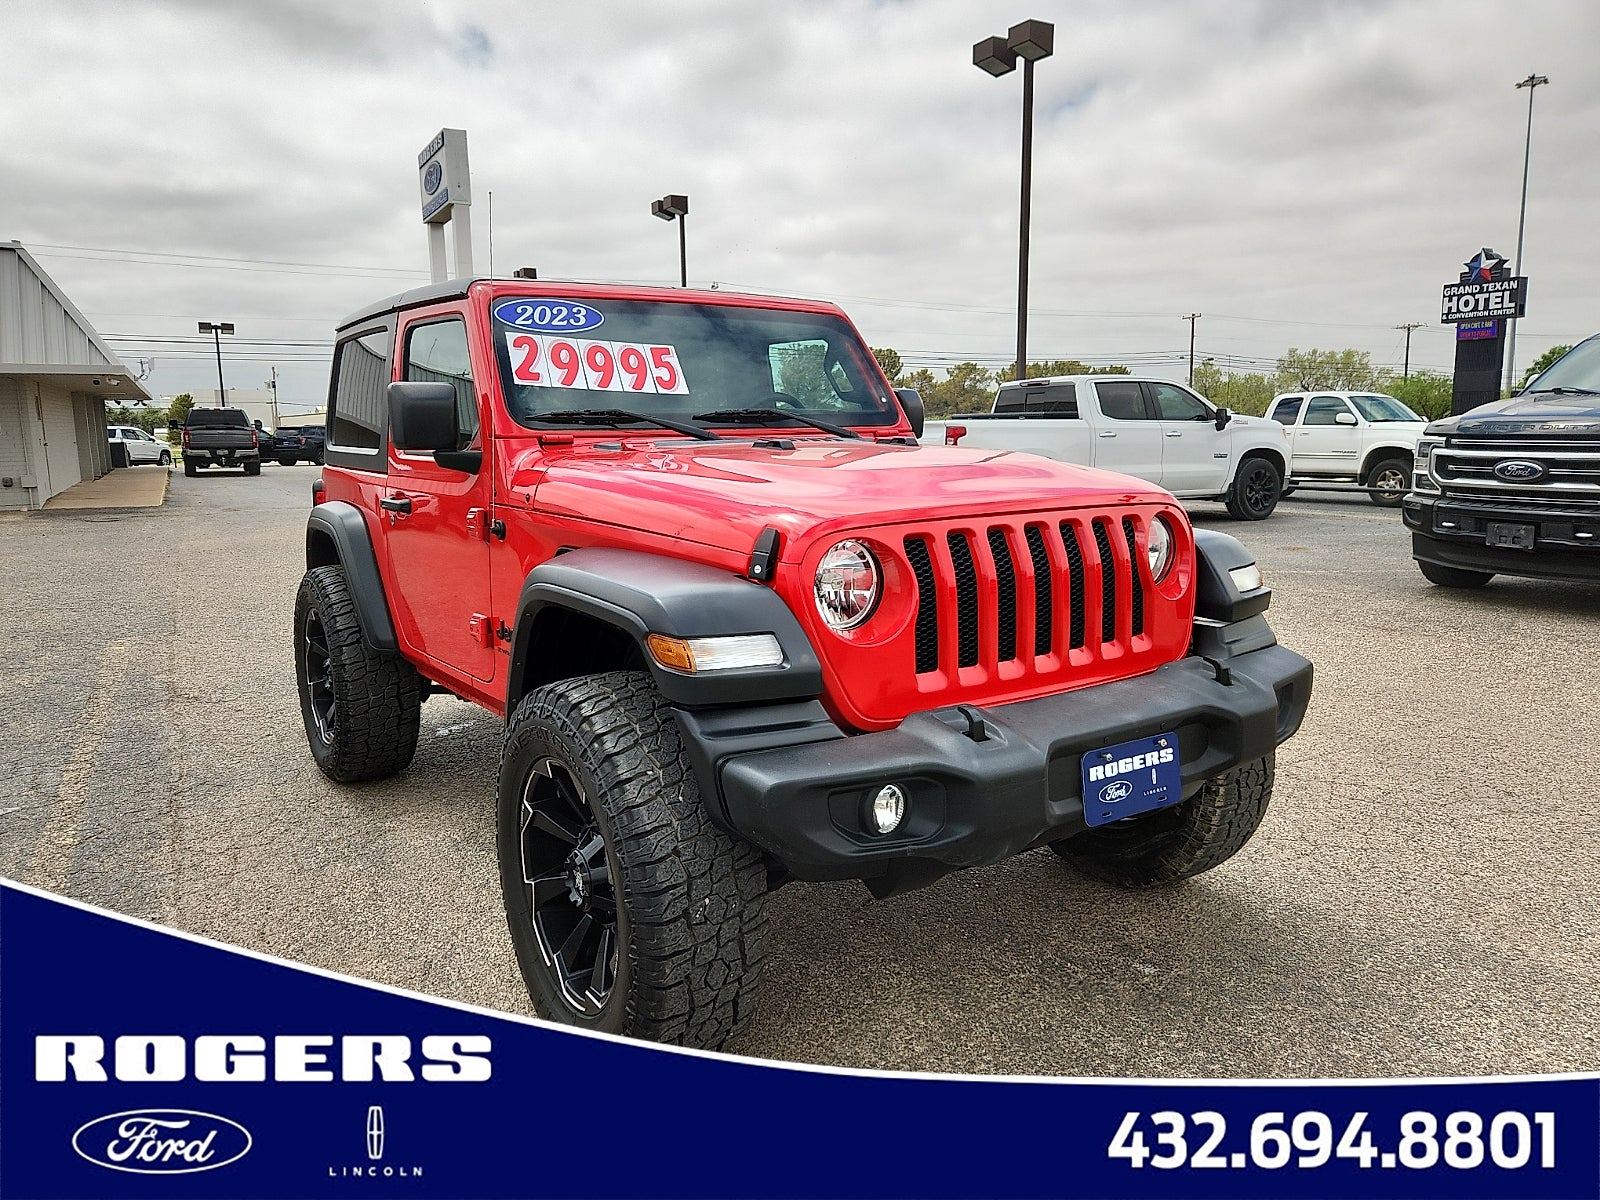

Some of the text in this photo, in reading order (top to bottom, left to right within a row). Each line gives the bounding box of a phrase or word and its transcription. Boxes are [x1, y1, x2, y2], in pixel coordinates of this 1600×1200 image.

[1443, 280, 1518, 296] GRAND TEXAN
[1443, 291, 1516, 314] HOTEL
[514, 305, 587, 326] 2023
[1448, 310, 1489, 320] CONVENTION
[1490, 308, 1515, 316] CENTER
[512, 335, 678, 391] 29995
[1504, 464, 1531, 478] Ford
[1089, 748, 1173, 782] ROGERS
[1105, 783, 1127, 801] Ford
[1143, 786, 1167, 796] LINCOLN
